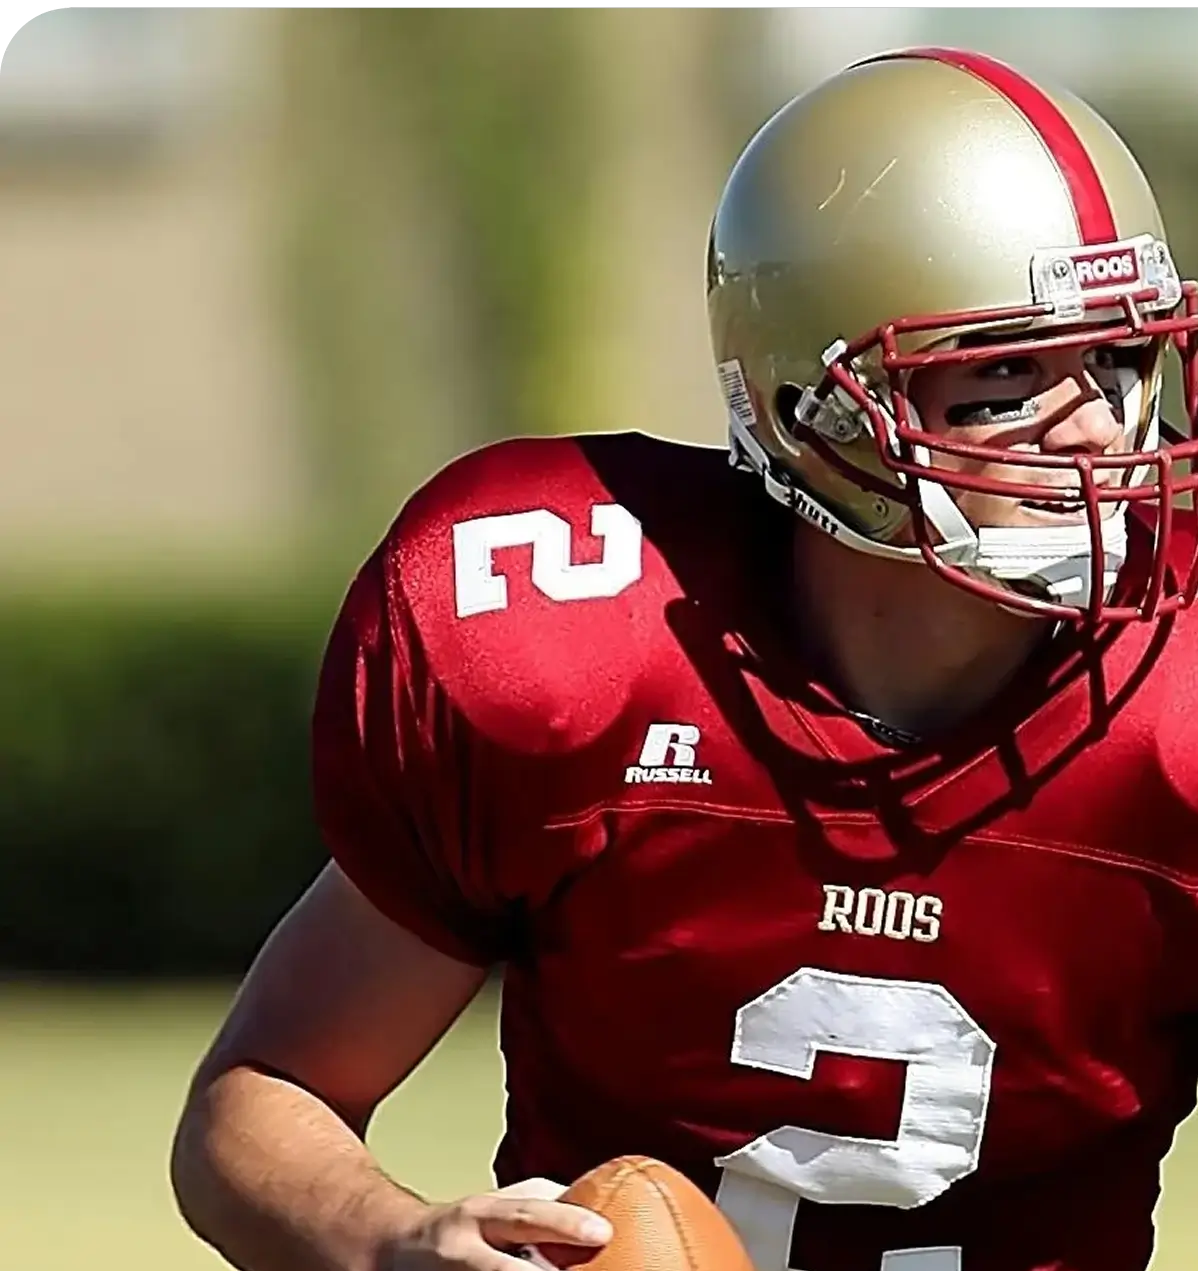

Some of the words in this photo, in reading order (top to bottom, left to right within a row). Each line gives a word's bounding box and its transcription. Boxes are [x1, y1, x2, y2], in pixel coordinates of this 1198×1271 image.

[1075, 254, 1135, 284] ROOS
[452, 503, 643, 619] 2
[639, 723, 701, 767] R
[624, 766, 713, 785] RUSSELL
[817, 884, 943, 942] ROOS
